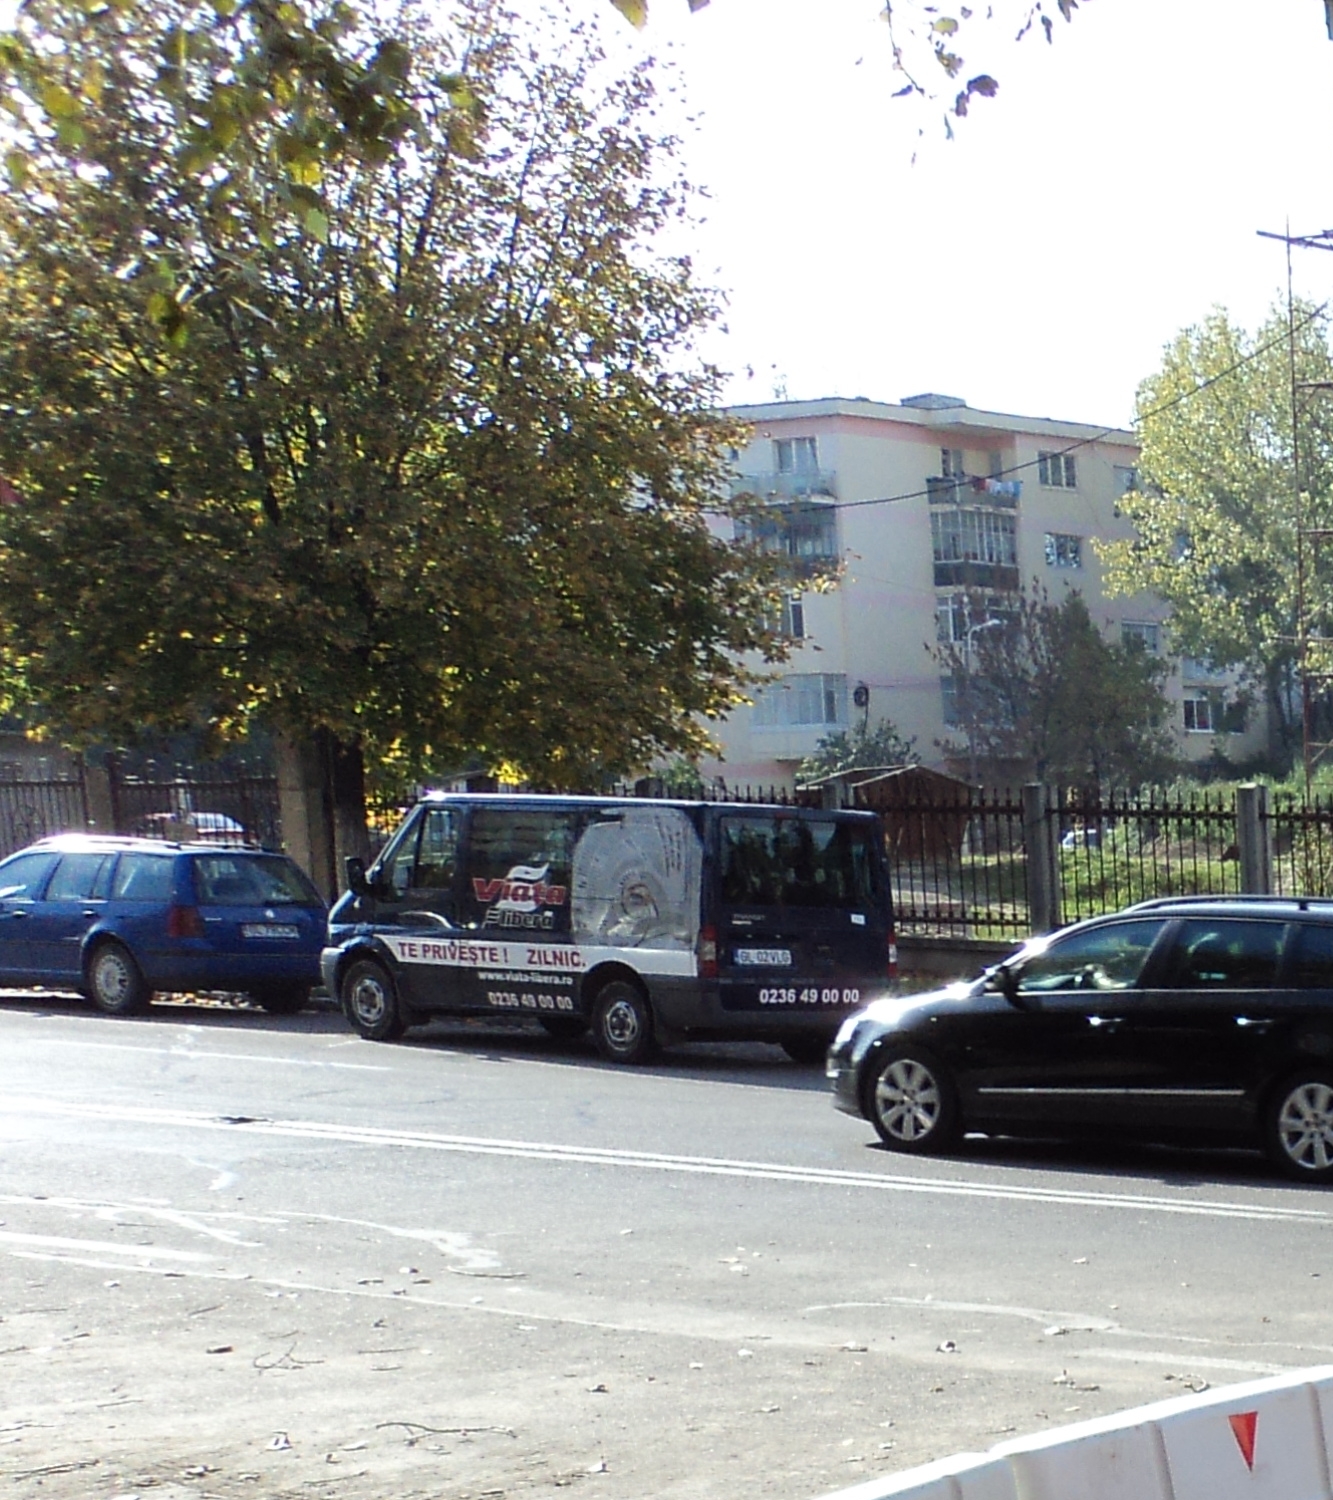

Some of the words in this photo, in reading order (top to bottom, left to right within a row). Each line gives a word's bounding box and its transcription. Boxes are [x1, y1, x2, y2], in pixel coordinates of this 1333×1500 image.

[398, 942, 417, 958] TE
[527, 949, 586, 967] ZILNIC.
[739, 950, 754, 964] GL
[488, 991, 520, 1007] 0236
[521, 993, 538, 1008] 49
[538, 995, 554, 1009] 00
[556, 996, 573, 1011] 00
[759, 989, 796, 1004] 0236
[799, 989, 818, 1003] 49
[821, 989, 839, 1003] 00
[843, 989, 860, 1003] 00
